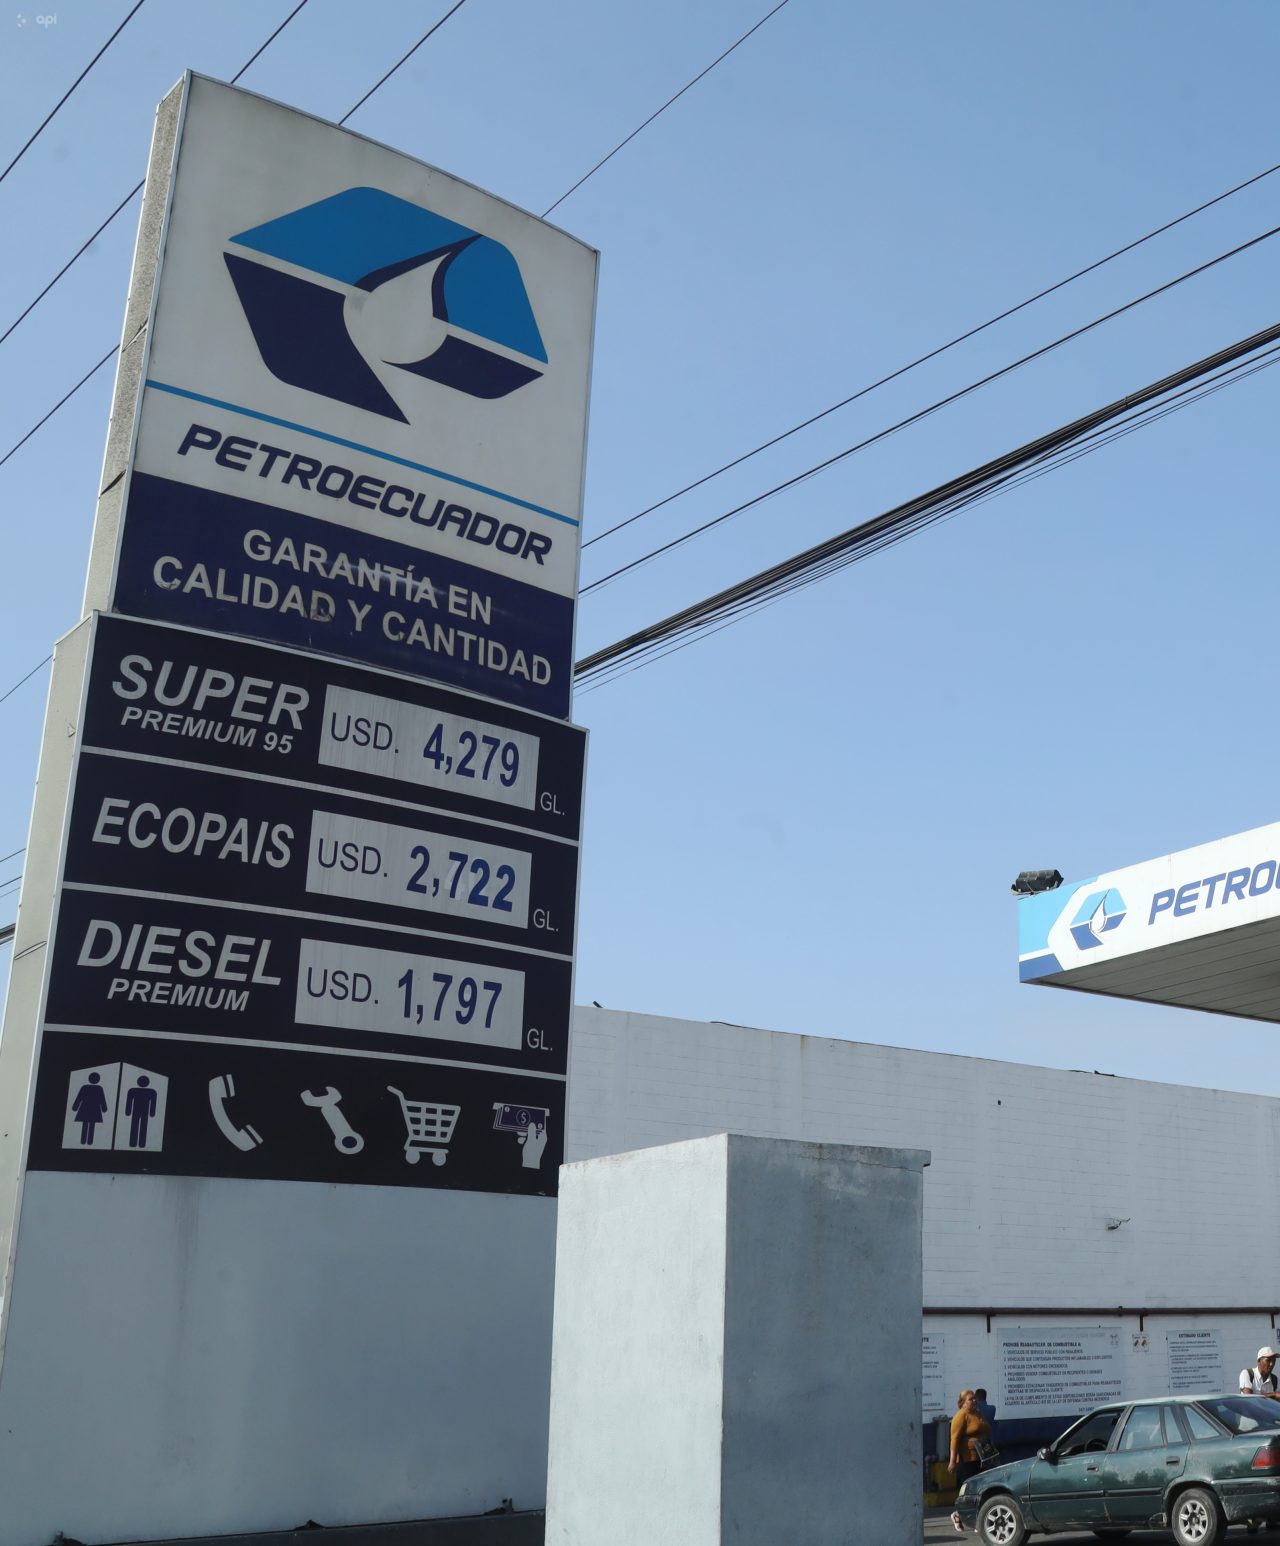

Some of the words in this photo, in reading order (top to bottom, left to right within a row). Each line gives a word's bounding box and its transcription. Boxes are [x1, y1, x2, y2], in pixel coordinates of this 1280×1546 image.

[177, 423, 552, 566] PETROECUADOR
[243, 528, 440, 609] GARANTÍA
[447, 587, 492, 625] EN
[152, 556, 336, 623] CALIDAD
[347, 597, 372, 632] Y
[381, 610, 552, 686] CANTIDAD
[111, 653, 310, 730] SUPER
[120, 706, 256, 748] PREMIUM
[263, 731, 294, 754] 95
[330, 712, 399, 753] USD.
[423, 723, 520, 787] 4,279
[540, 792, 566, 816] GL.
[92, 797, 295, 868] ECOPAIS
[317, 838, 389, 878] USD.
[406, 845, 516, 912] 2,722
[533, 909, 559, 933] GL.
[77, 920, 283, 985] DIESEL
[106, 978, 250, 1012] PREMIUM
[306, 967, 379, 1005] USD.
[397, 969, 503, 1029] 1,797
[526, 1029, 553, 1052] GL.
